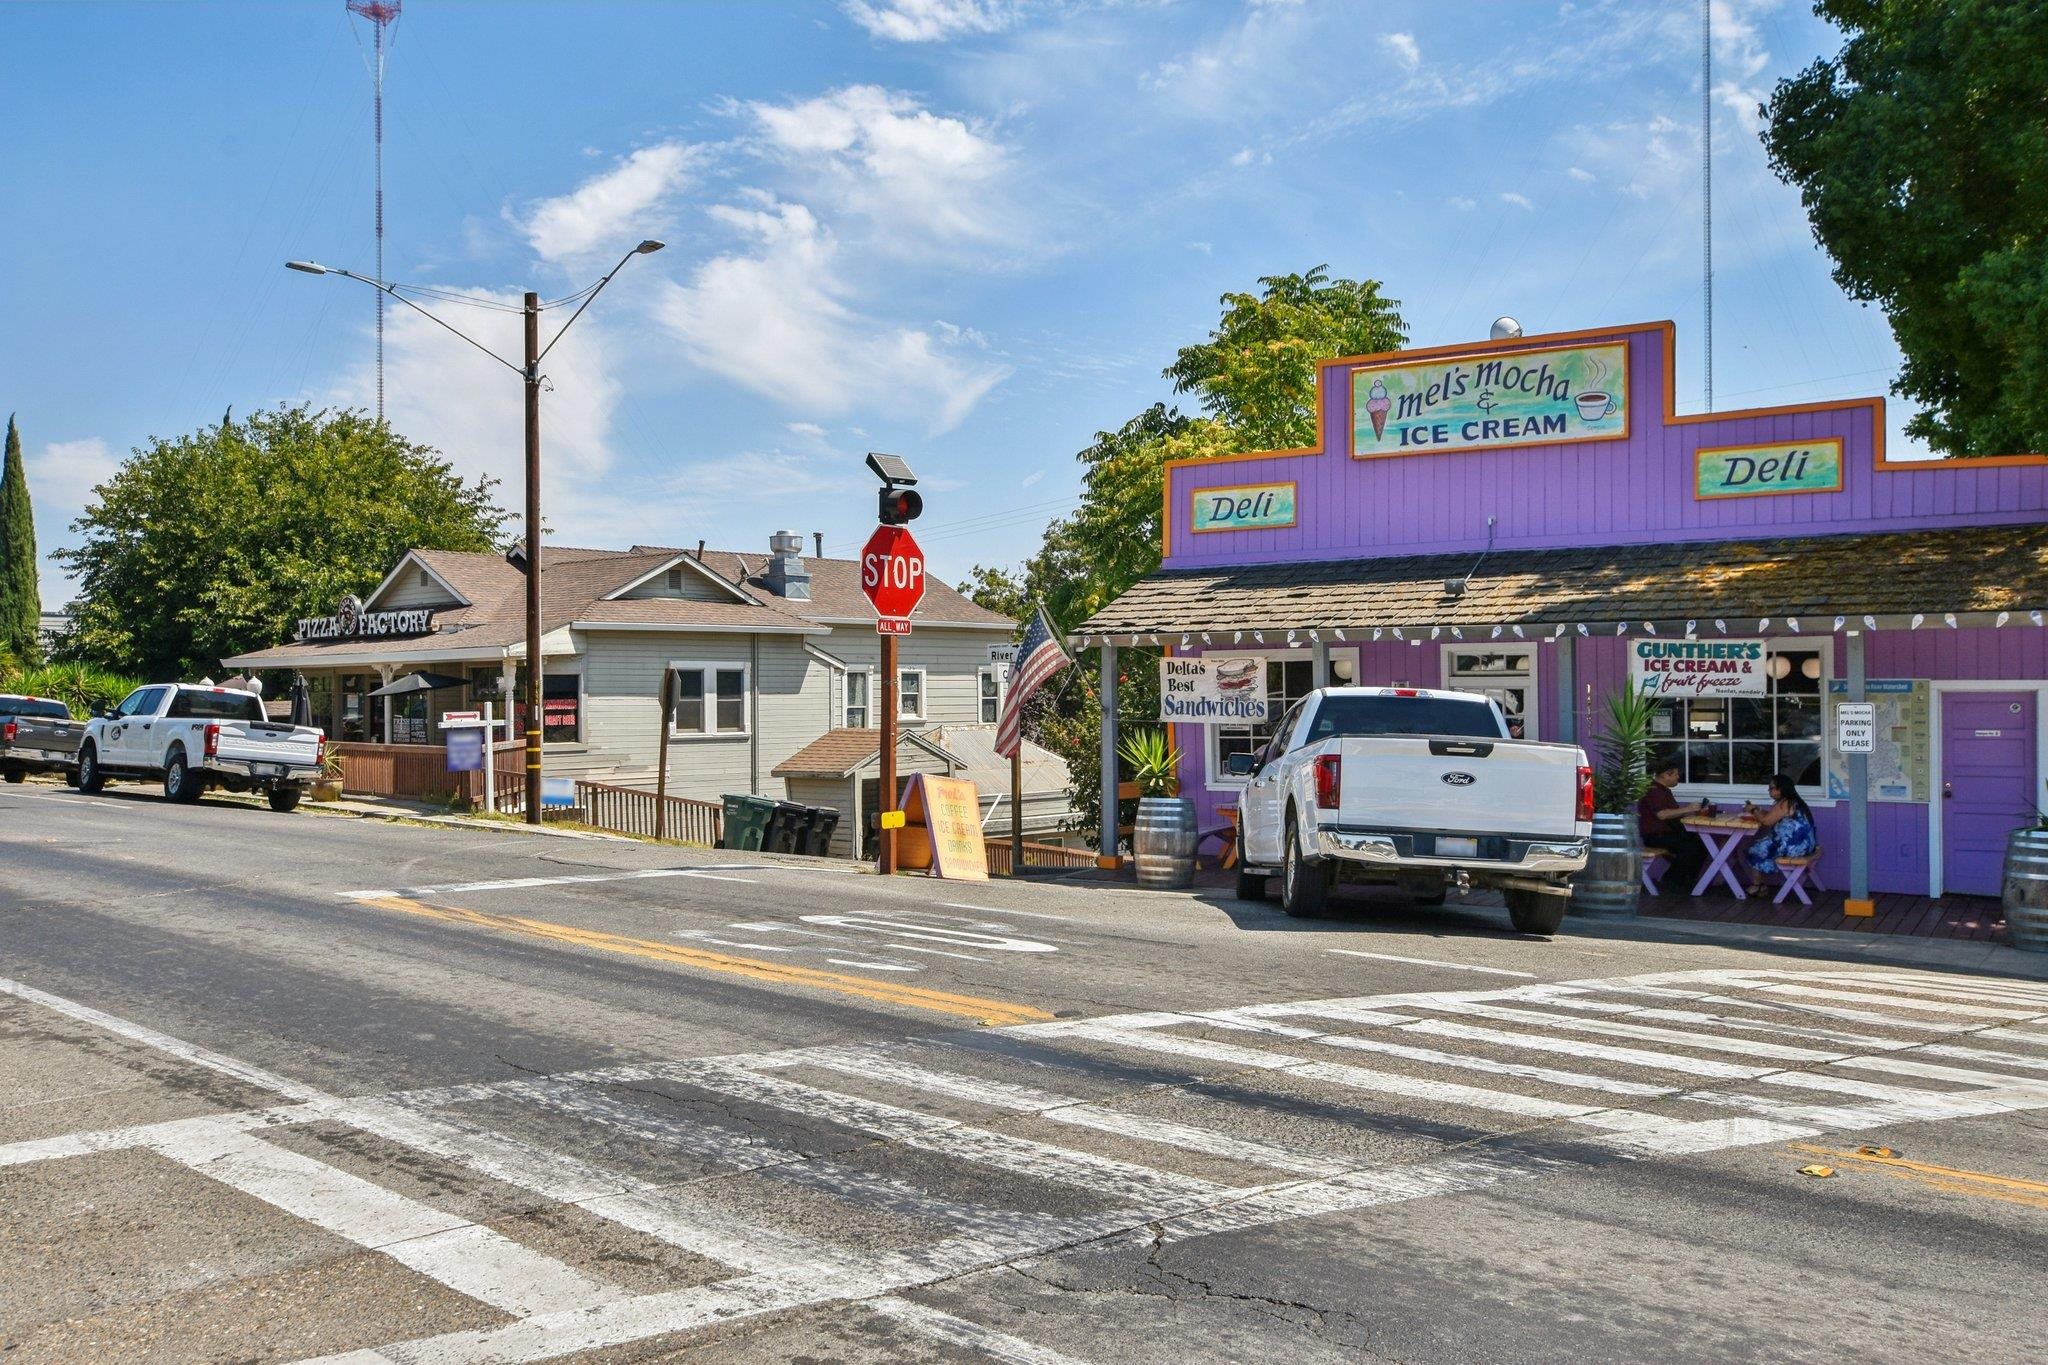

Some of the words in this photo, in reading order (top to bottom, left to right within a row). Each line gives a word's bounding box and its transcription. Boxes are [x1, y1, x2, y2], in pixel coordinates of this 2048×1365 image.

[1476, 388, 1499, 415] &
[1400, 424, 1449, 447] ICE
[1461, 413, 1567, 441] CREAM
[1720, 450, 1810, 486] Deli
[1209, 492, 1274, 521] Deli
[865, 553, 922, 590] STOP
[298, 616, 340, 638] PIZZA
[358, 610, 429, 635] FACTORY
[880, 623, 892, 631] ALL
[896, 623, 908, 632] WAY
[991, 651, 1013, 661] River
[1637, 641, 1762, 659] GUNTHER'S
[1166, 661, 1206, 675] Delta's
[1644, 659, 1670, 672] ICE
[1673, 660, 1738, 673] CREAM
[1741, 661, 1752, 673] &
[1168, 678, 1195, 692] Best
[1661, 672, 1697, 692] fruit
[1694, 673, 1742, 693] freeze
[1164, 694, 1265, 718] Sandwiches
[941, 804, 969, 818] COFFEE
[937, 820, 950, 834] ICE
